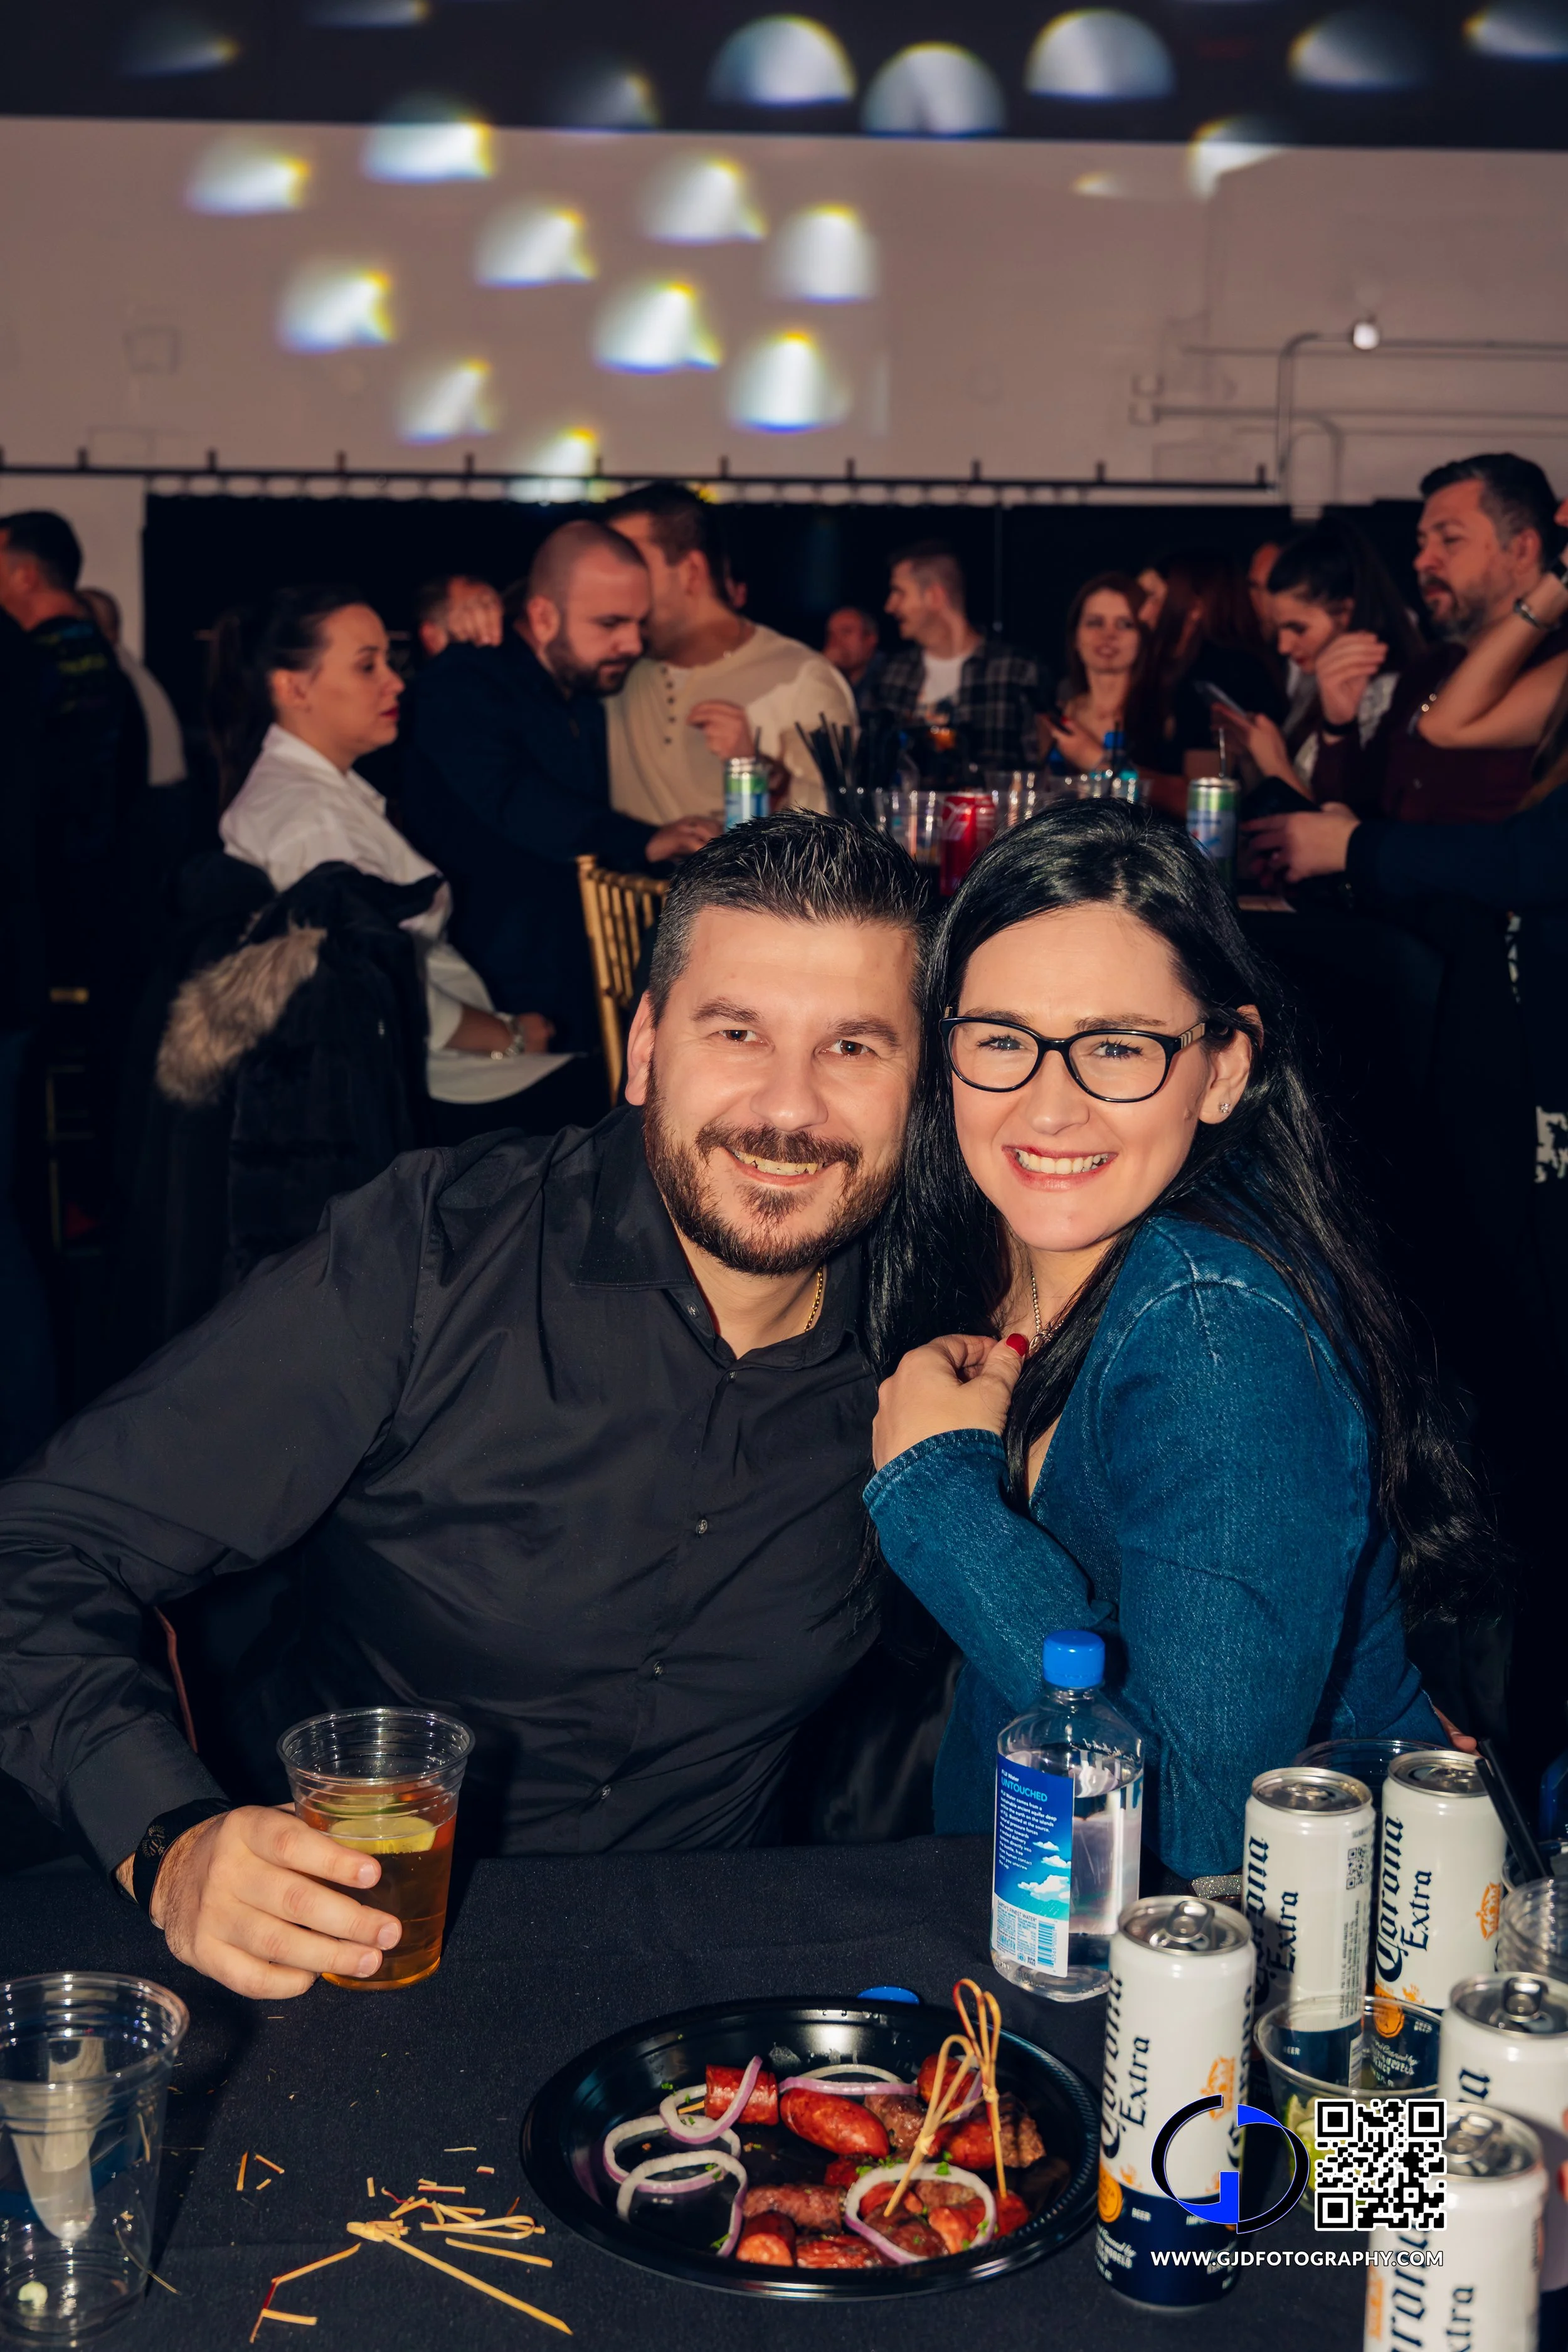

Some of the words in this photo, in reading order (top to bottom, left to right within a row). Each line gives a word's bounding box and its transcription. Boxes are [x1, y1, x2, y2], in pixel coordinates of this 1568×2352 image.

[1001, 1776, 1047, 1802] UNTOUCHED
[1269, 1890, 1299, 1974] Extra
[1375, 1815, 1409, 1983] Corona
[1401, 1869, 1433, 1951] Extra
[1120, 2036, 1150, 2128] Extra
[1283, 2045, 1301, 2055] EER
